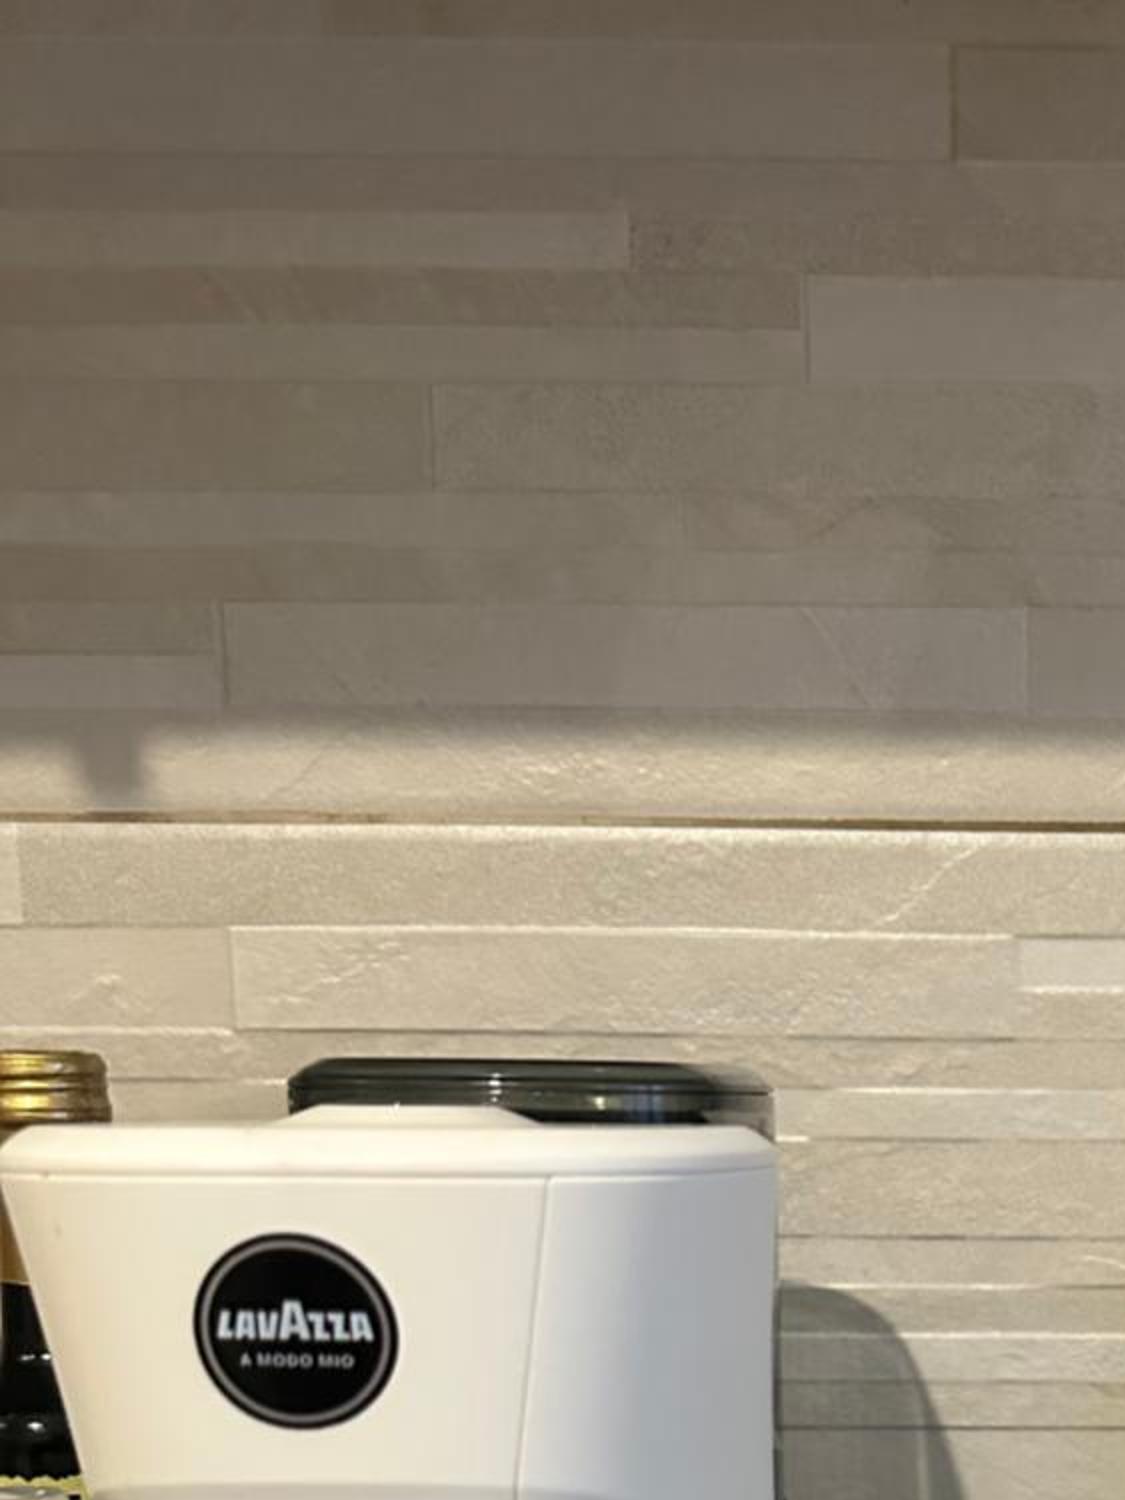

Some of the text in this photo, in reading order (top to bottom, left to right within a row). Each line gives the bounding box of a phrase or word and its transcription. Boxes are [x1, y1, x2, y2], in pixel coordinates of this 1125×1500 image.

[216, 1299, 375, 1342] LAVAZZA
[240, 1353, 355, 1369] A MODO MIO
